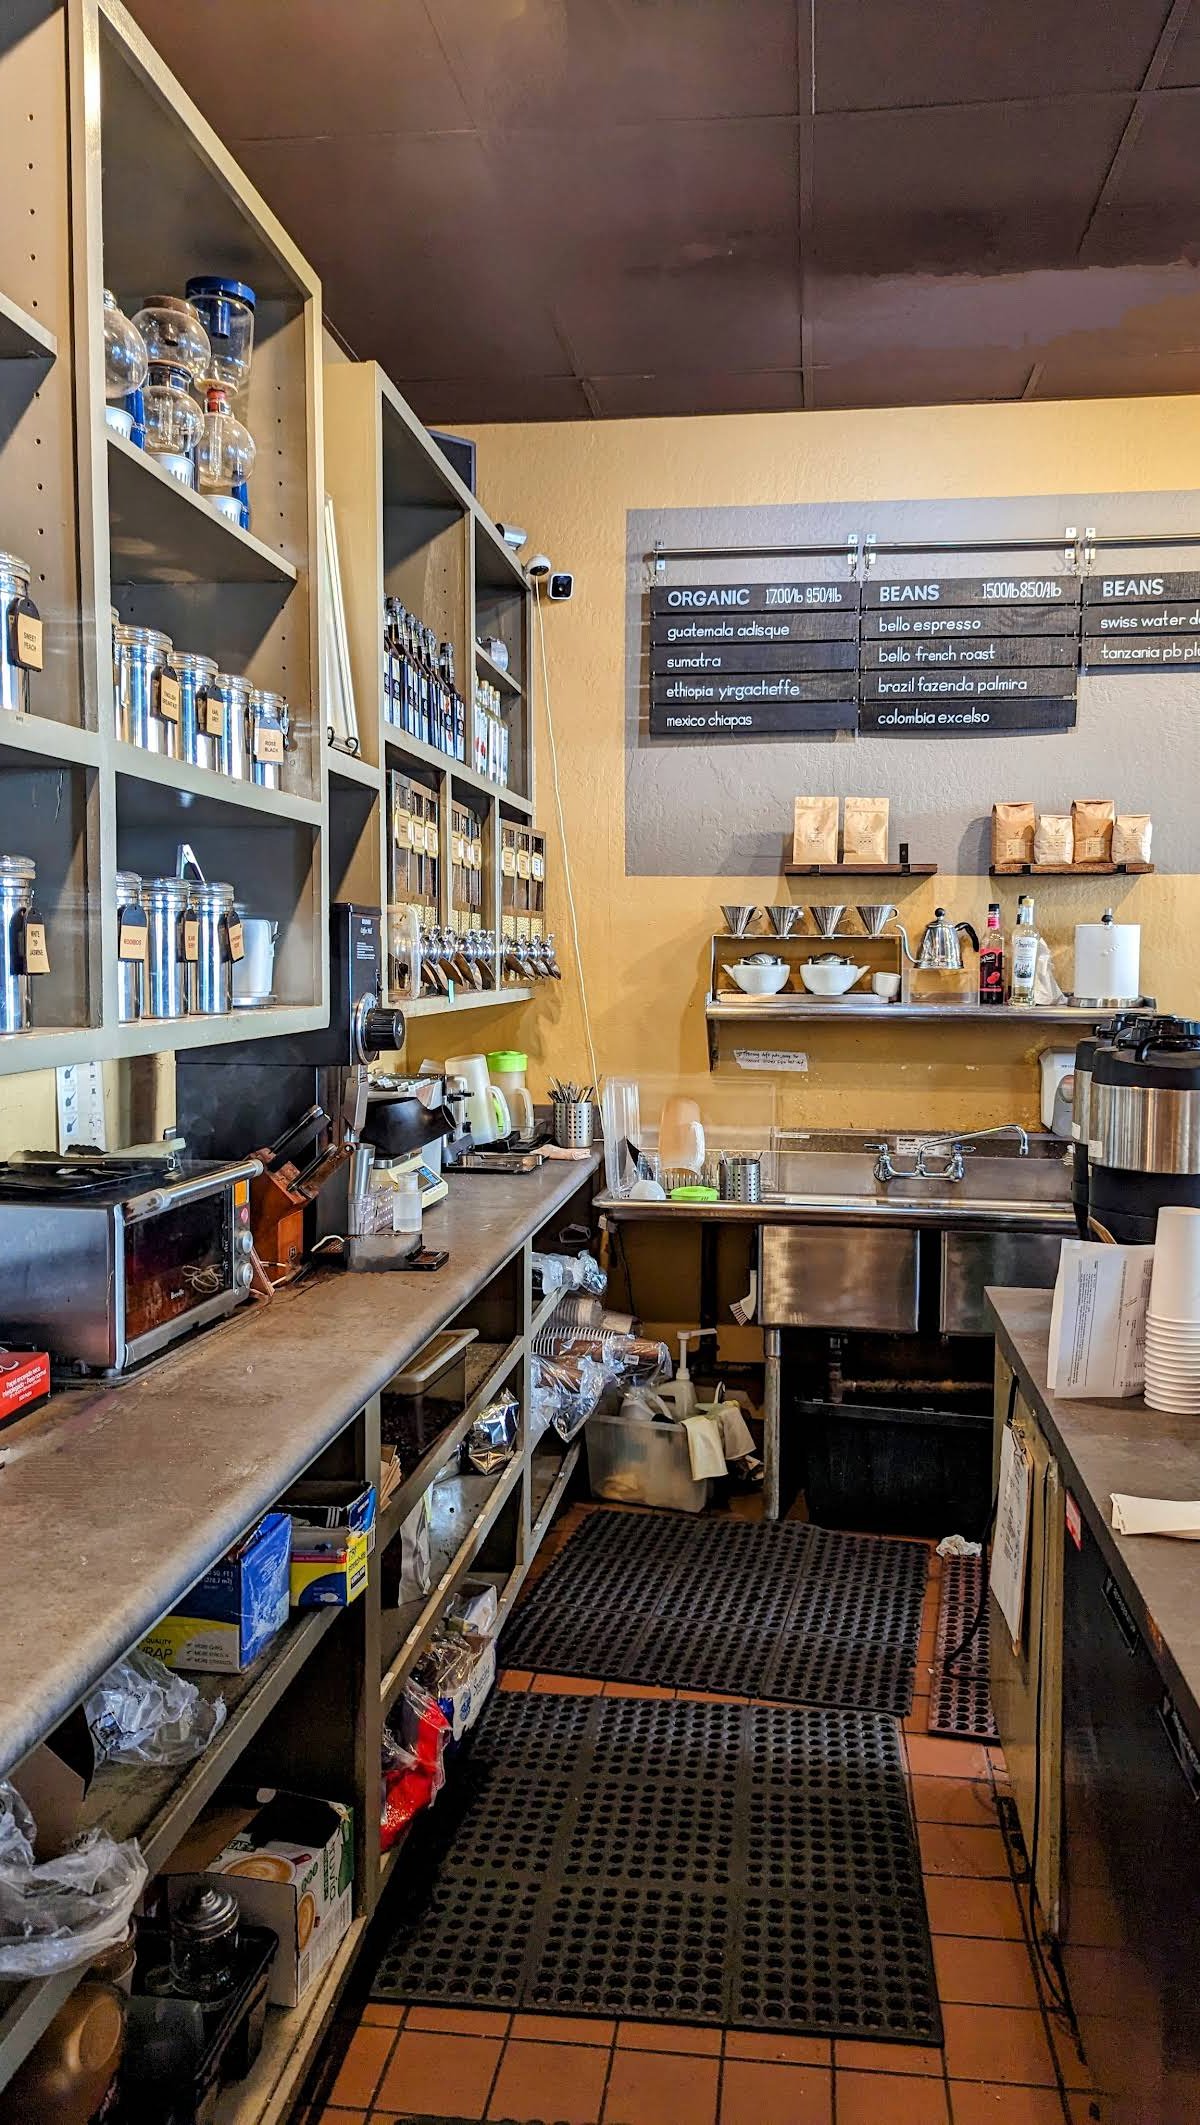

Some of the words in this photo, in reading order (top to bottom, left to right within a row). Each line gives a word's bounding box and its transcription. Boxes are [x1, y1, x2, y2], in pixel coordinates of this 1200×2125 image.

[879, 584, 941, 602] BEANS
[1102, 578, 1164, 597] BEANS
[667, 588, 750, 607] ORGANIC
[879, 616, 910, 633] bello
[913, 619, 981, 635] espresso
[1100, 616, 1138, 629] swiss
[1141, 610, 1187, 627] water
[667, 621, 734, 641] guatemala
[737, 620, 790, 639] adisque
[666, 652, 721, 668] sumatra
[878, 646, 911, 663] bello
[915, 645, 956, 662] french
[960, 644, 996, 661] roast
[1100, 643, 1160, 659] tanzania
[1162, 642, 1182, 661] pb
[666, 682, 714, 700] ethiopia
[718, 679, 801, 701] yirgacheffe
[878, 677, 915, 694] brazil
[917, 676, 974, 692] fazenda
[977, 675, 1028, 694] palmira
[666, 715, 706, 727] mexico
[708, 711, 753, 729] chiapas
[877, 708, 935, 725] colombia
[937, 707, 990, 724] excelso
